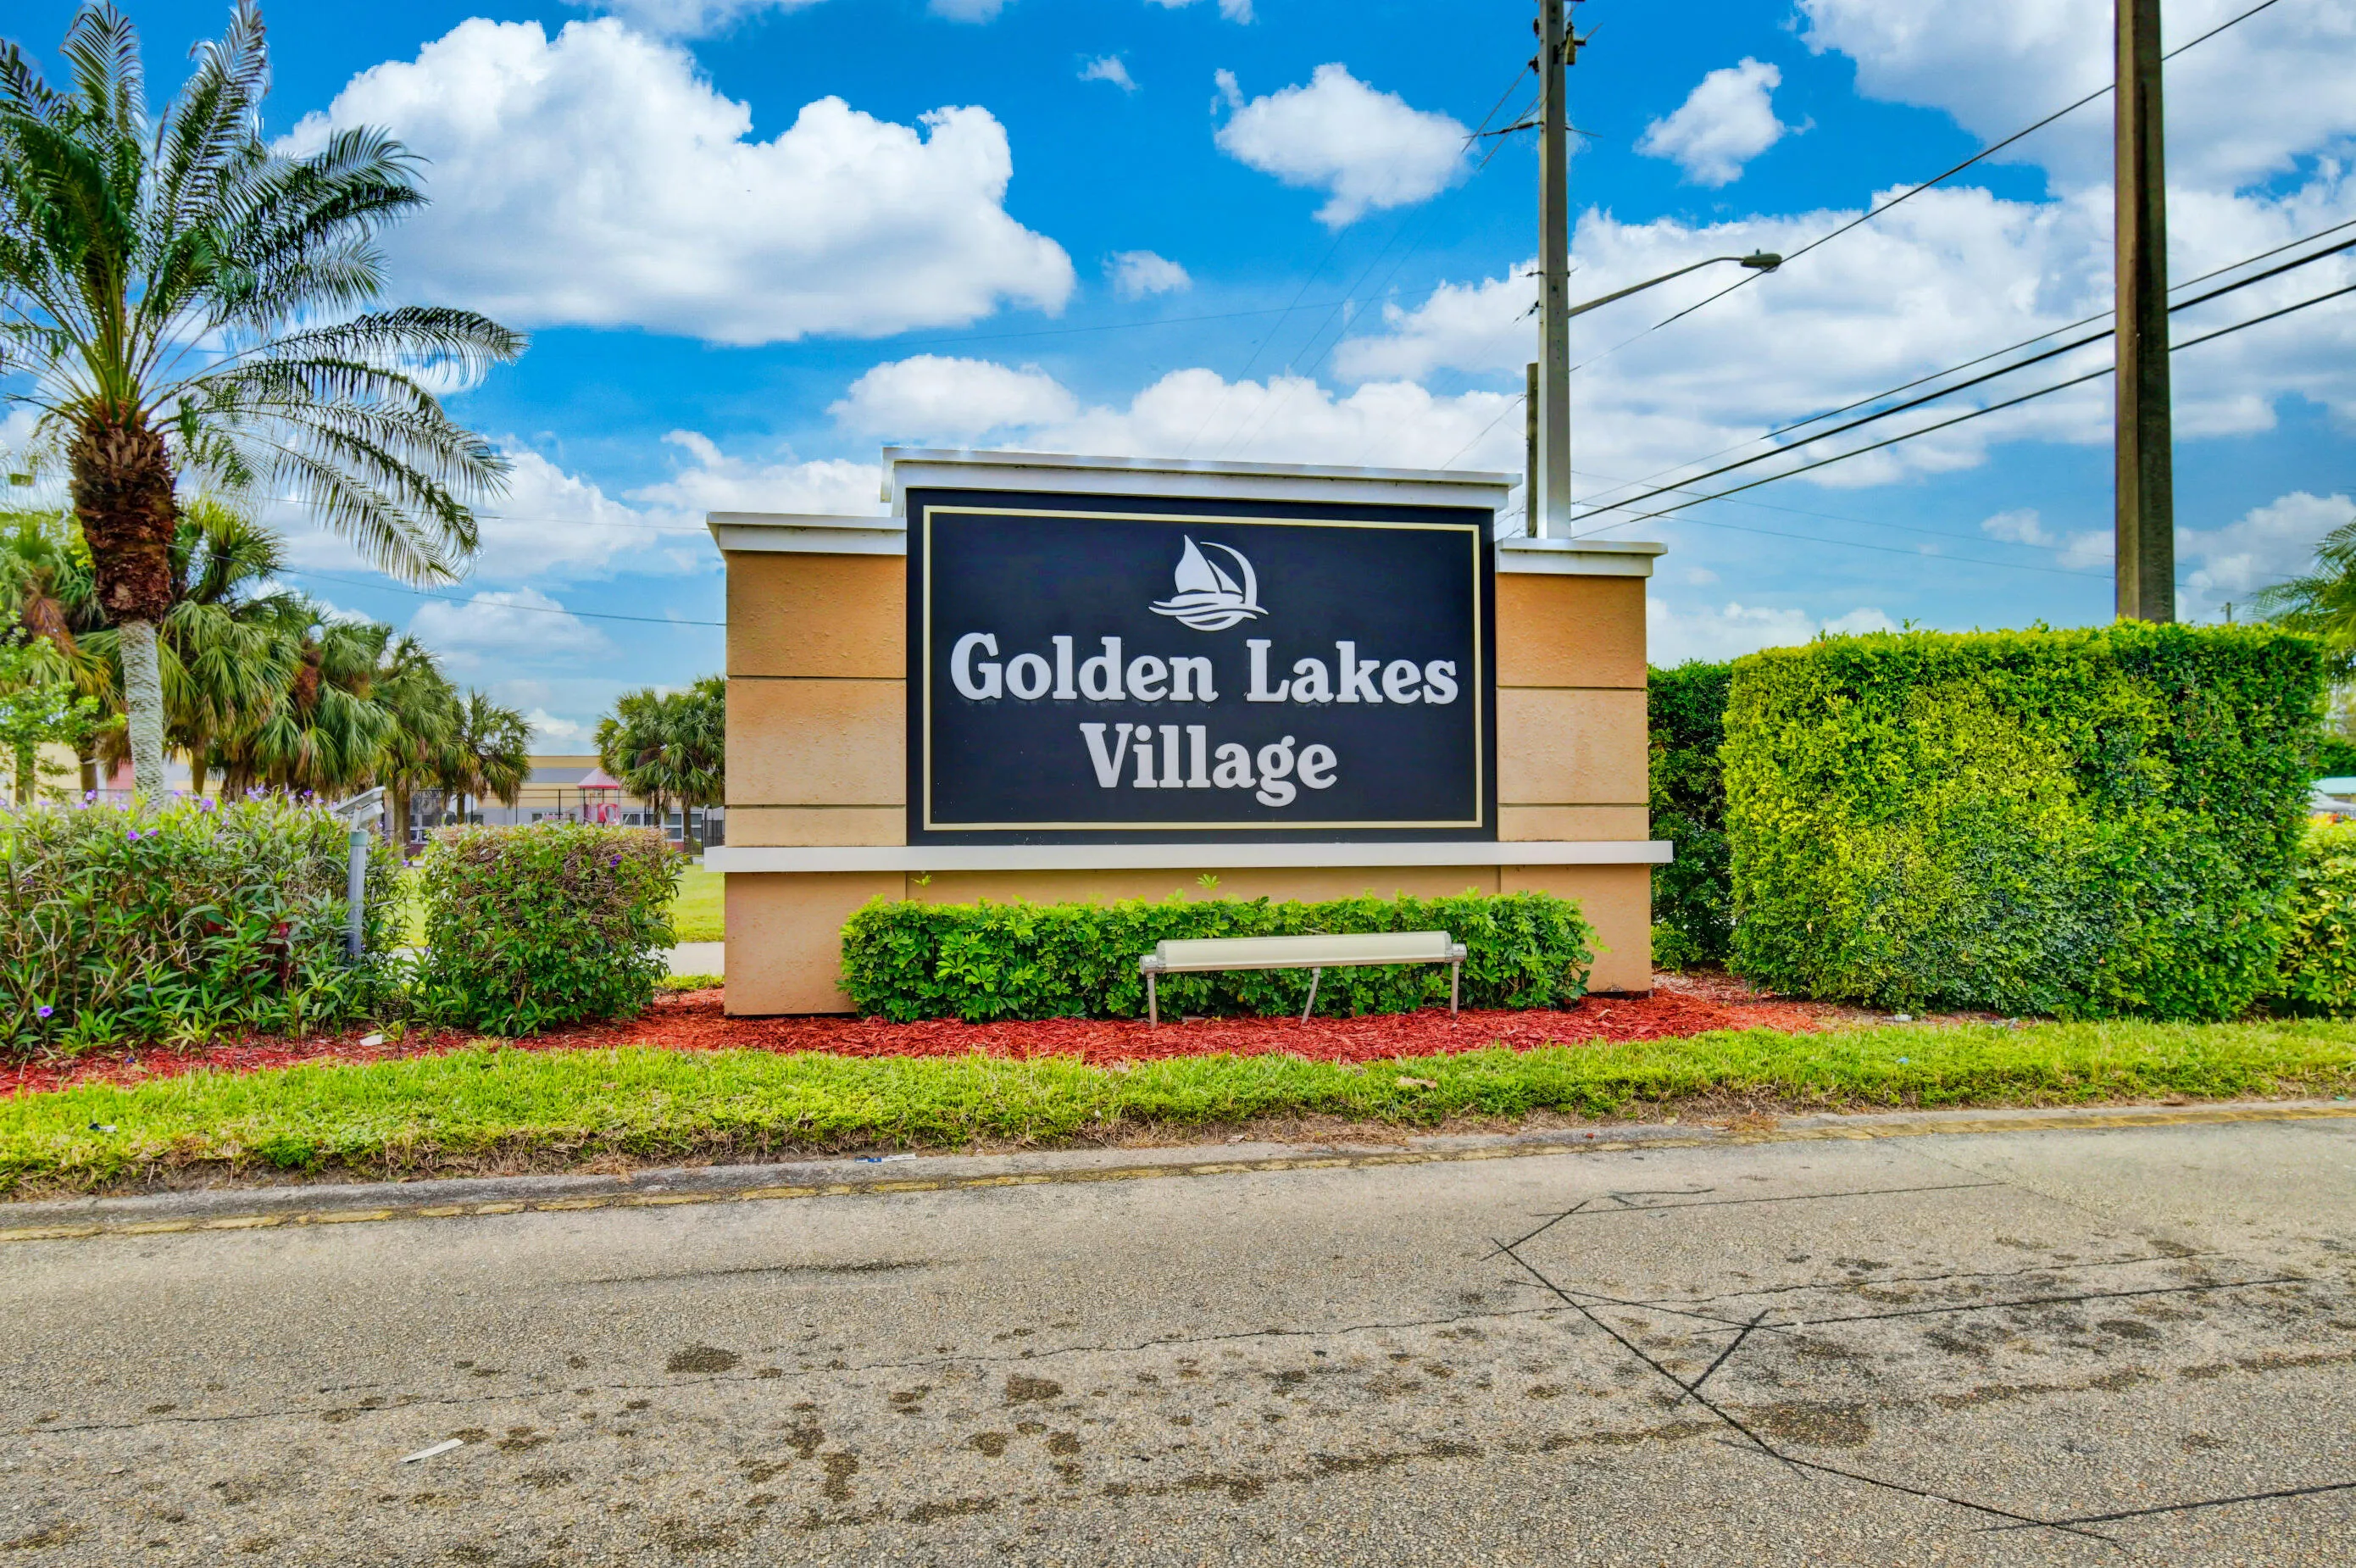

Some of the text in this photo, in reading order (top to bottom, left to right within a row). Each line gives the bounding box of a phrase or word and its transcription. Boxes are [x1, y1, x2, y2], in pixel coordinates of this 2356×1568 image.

[950, 632, 1459, 705] Golden Lakes
[1079, 722, 1337, 808] Village
